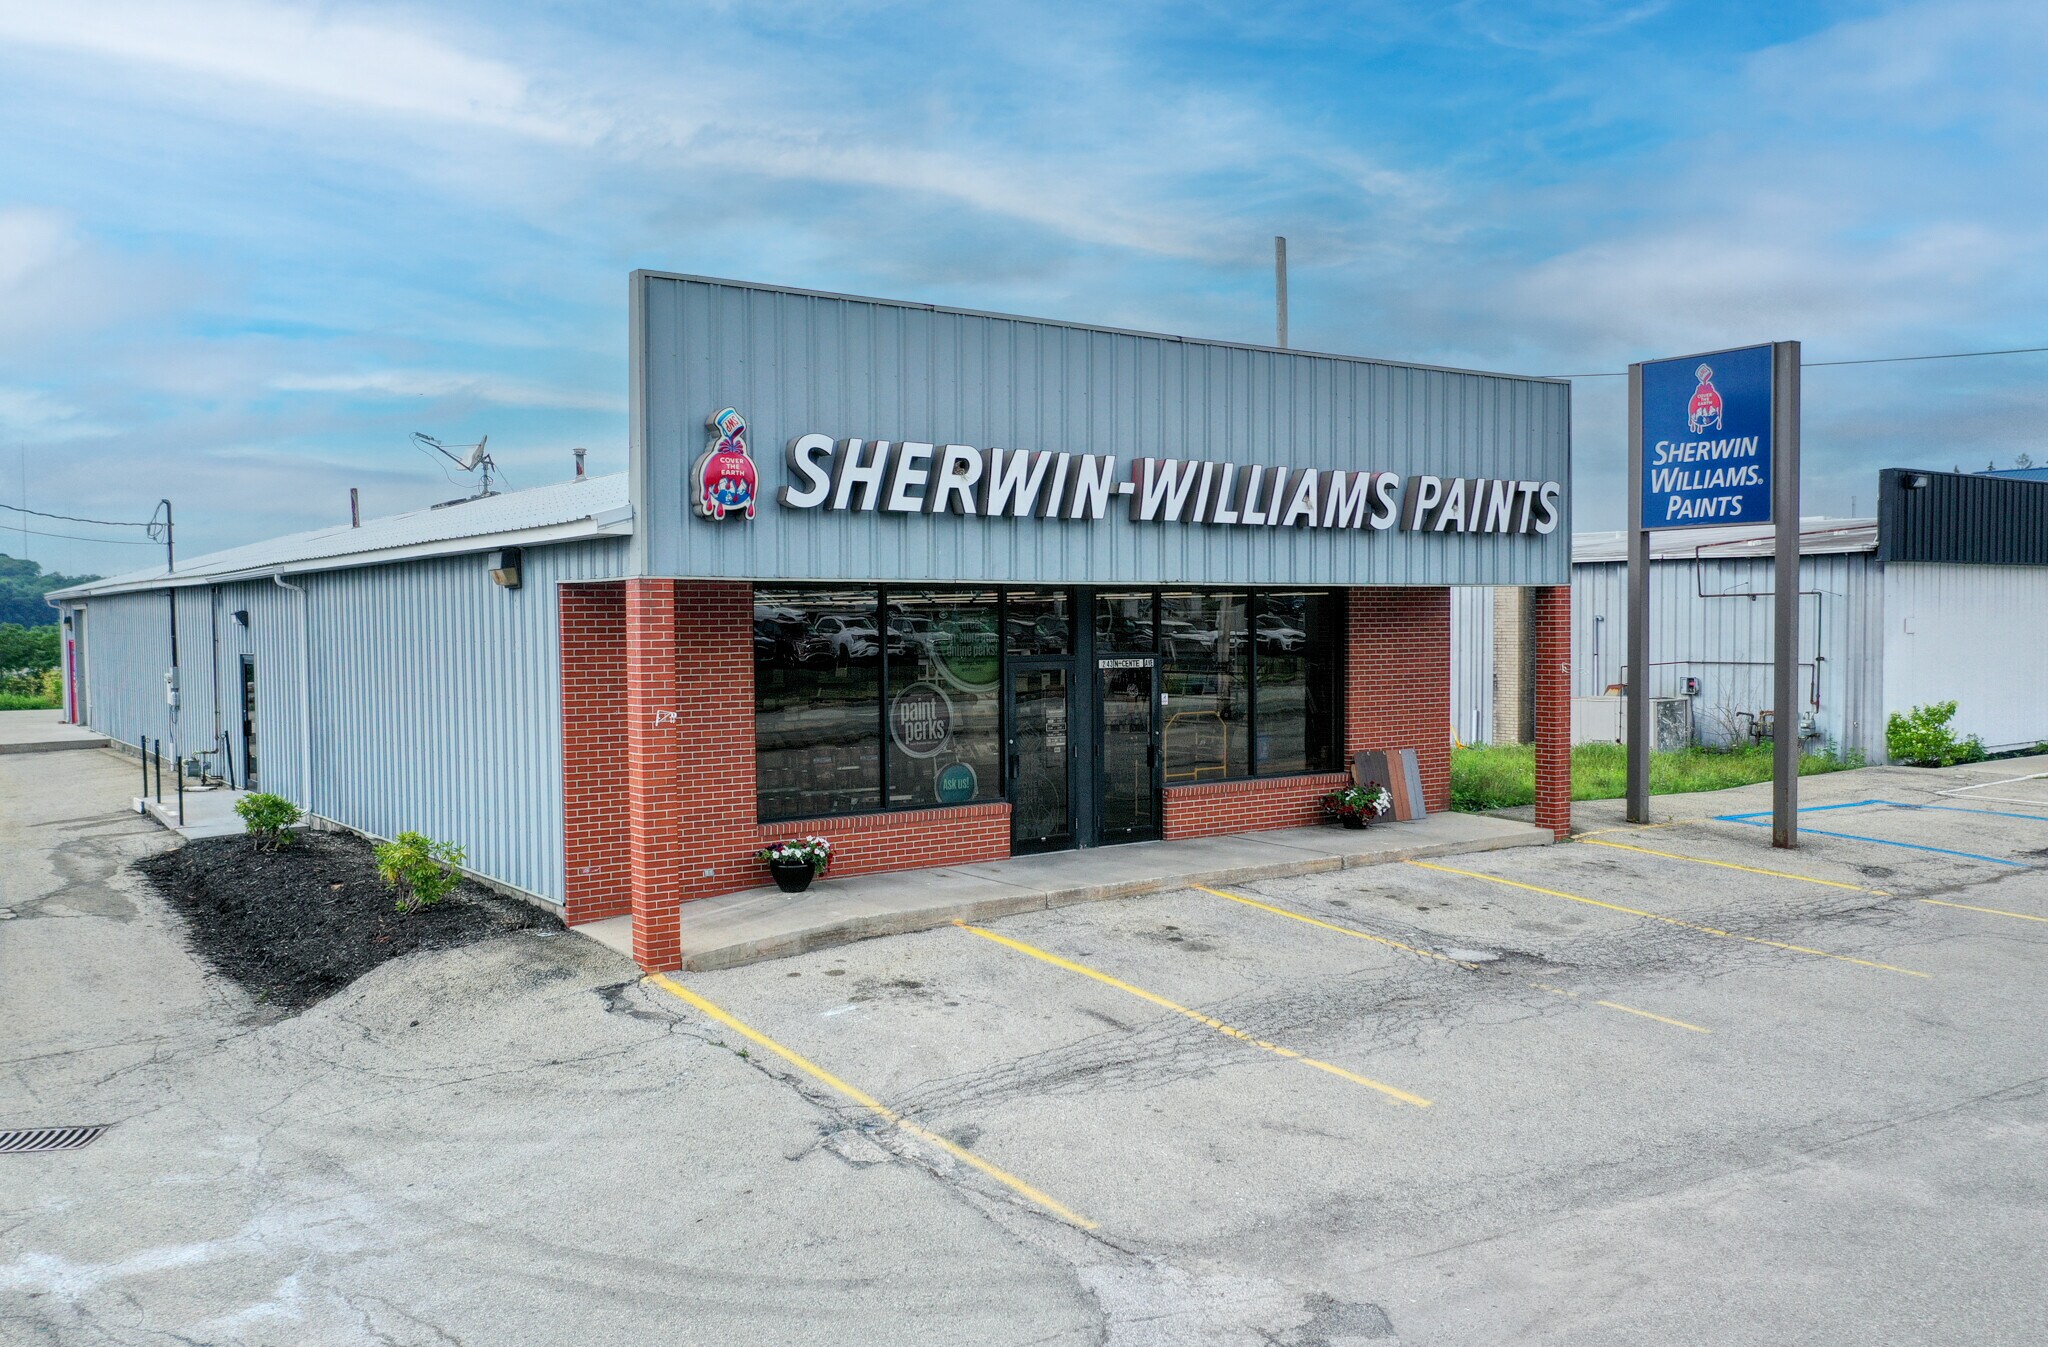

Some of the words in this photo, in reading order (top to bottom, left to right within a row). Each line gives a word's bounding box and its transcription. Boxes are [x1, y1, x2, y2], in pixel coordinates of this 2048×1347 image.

[1652, 436, 1759, 466] SHERWIN
[784, 433, 1400, 531] SHERWIN-WILLIAMS
[1410, 475, 1561, 535] PAINTS
[1665, 495, 1743, 521] PAINTS
[900, 697, 937, 726] paint
[904, 717, 945, 745] perks
[943, 777, 957, 791] Ask
[958, 776, 970, 790] us!
